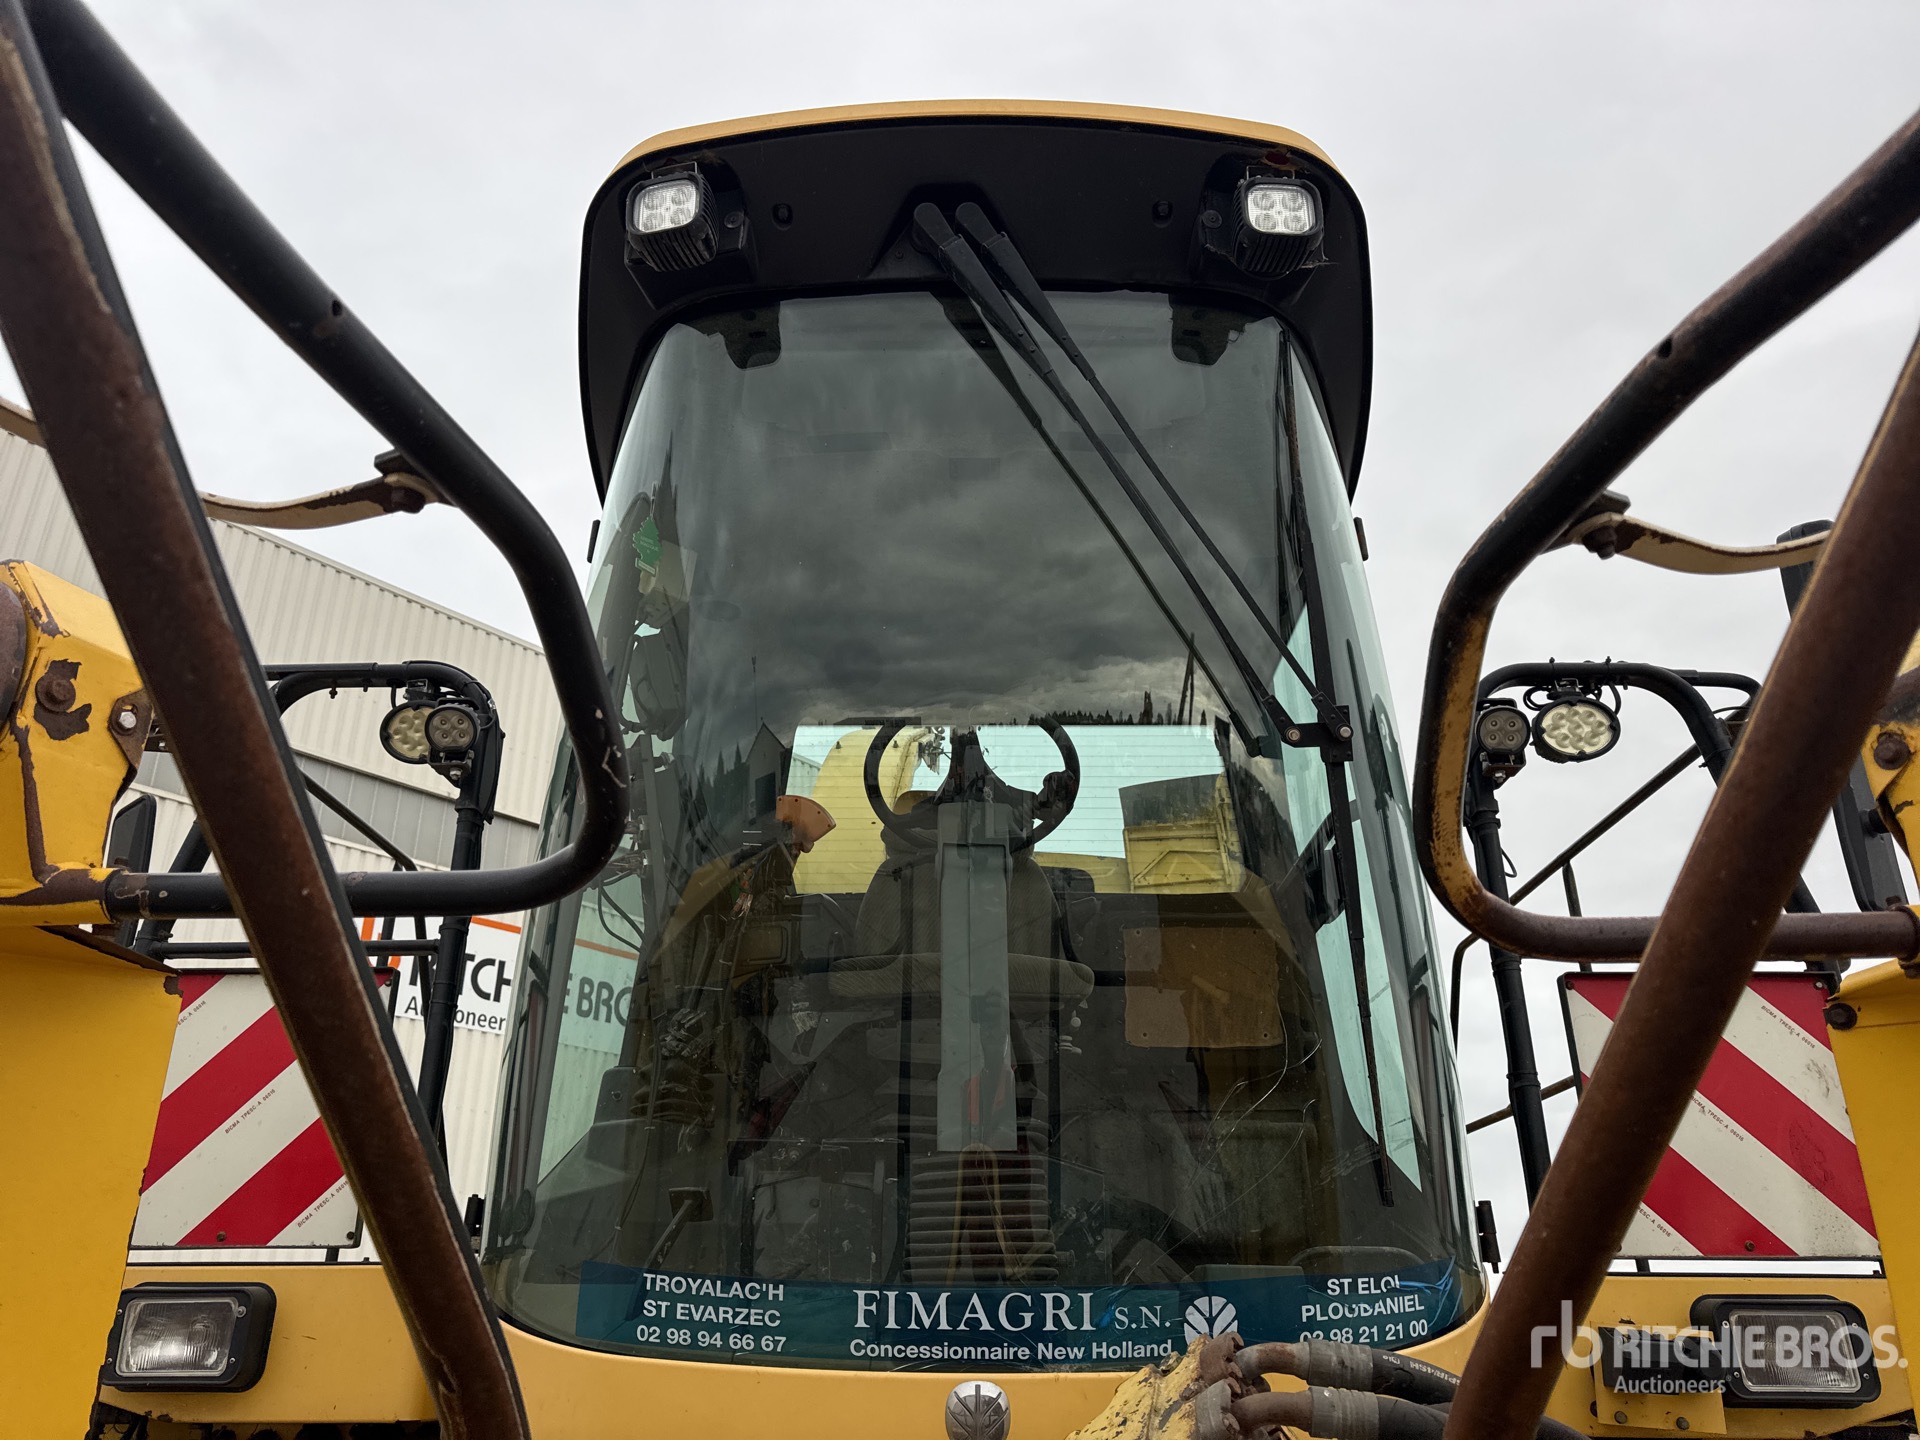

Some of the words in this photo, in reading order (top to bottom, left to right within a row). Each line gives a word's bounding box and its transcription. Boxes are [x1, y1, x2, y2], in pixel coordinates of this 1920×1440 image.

[643, 1273, 784, 1301] TROYALAC'H
[1327, 1278, 1352, 1295] ST
[643, 1300, 670, 1318] ST
[676, 1302, 780, 1327] EVARZEC
[853, 1290, 1096, 1332] FIMAGRI
[1114, 1306, 1171, 1330] S.N.
[636, 1325, 660, 1342] 02
[666, 1328, 691, 1346] 98
[698, 1331, 722, 1348] 94
[729, 1333, 754, 1350] 66
[761, 1336, 786, 1352] 67
[1330, 1328, 1353, 1344] 98
[1359, 1326, 1378, 1343] 21
[1386, 1323, 1404, 1340] 21
[1410, 1319, 1428, 1337] 00
[850, 1339, 1030, 1360] Concessionnaire
[1038, 1342, 1084, 1360] New
[1092, 1339, 1172, 1359] Holland
